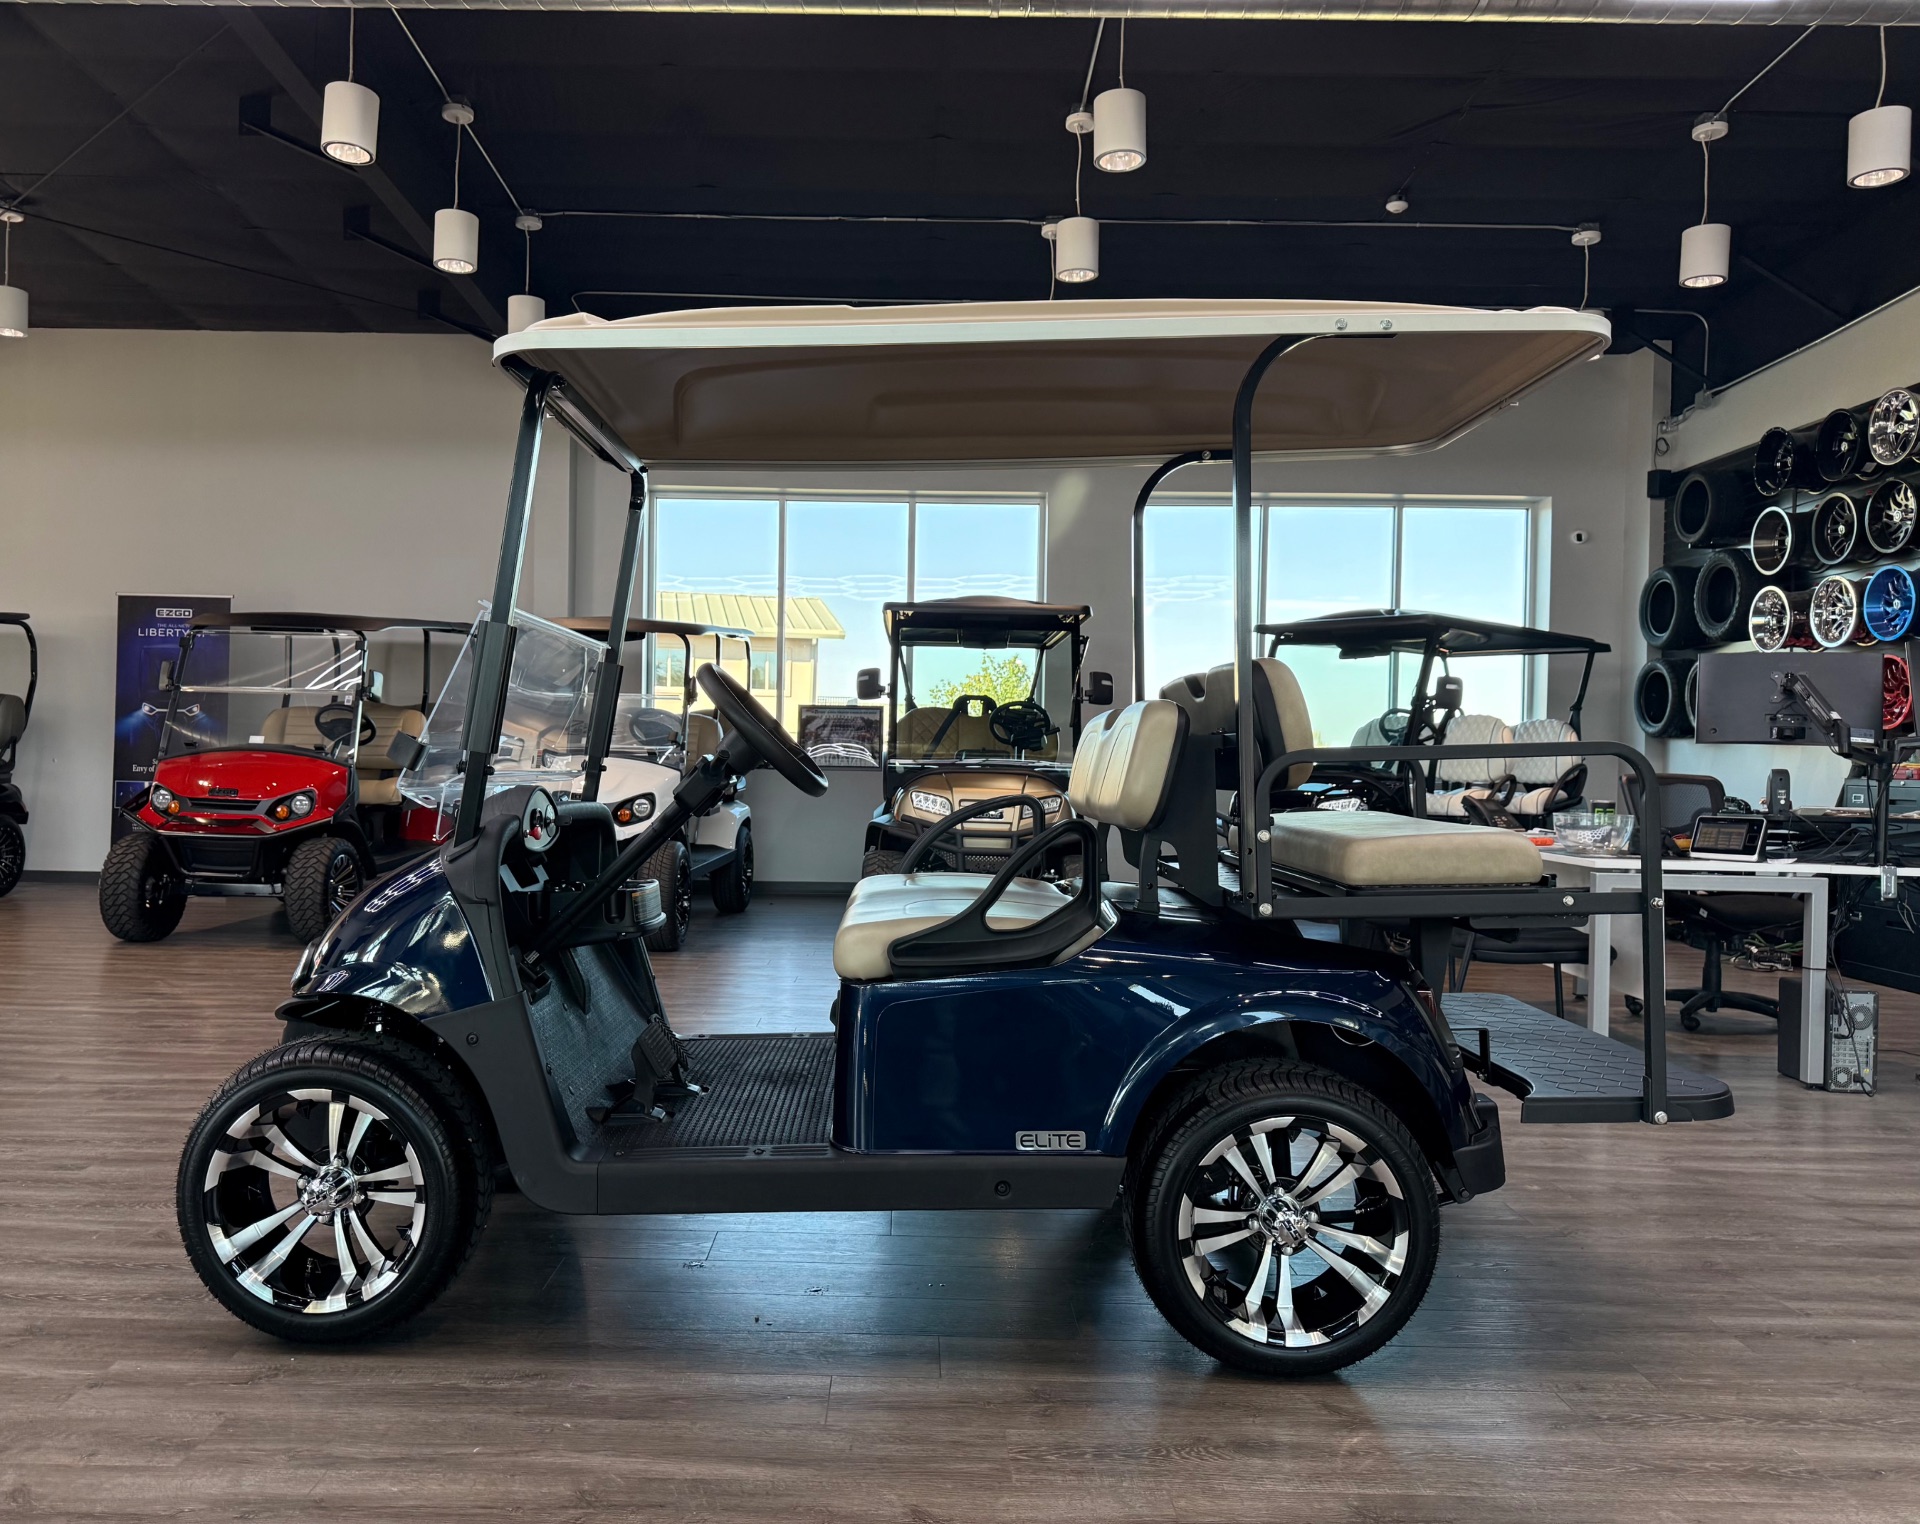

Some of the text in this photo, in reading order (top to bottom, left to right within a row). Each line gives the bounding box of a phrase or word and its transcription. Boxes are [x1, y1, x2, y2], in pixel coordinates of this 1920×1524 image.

[157, 609, 192, 617] EZGO
[138, 628, 190, 637] LIBERTY
[132, 764, 148, 774] Envy
